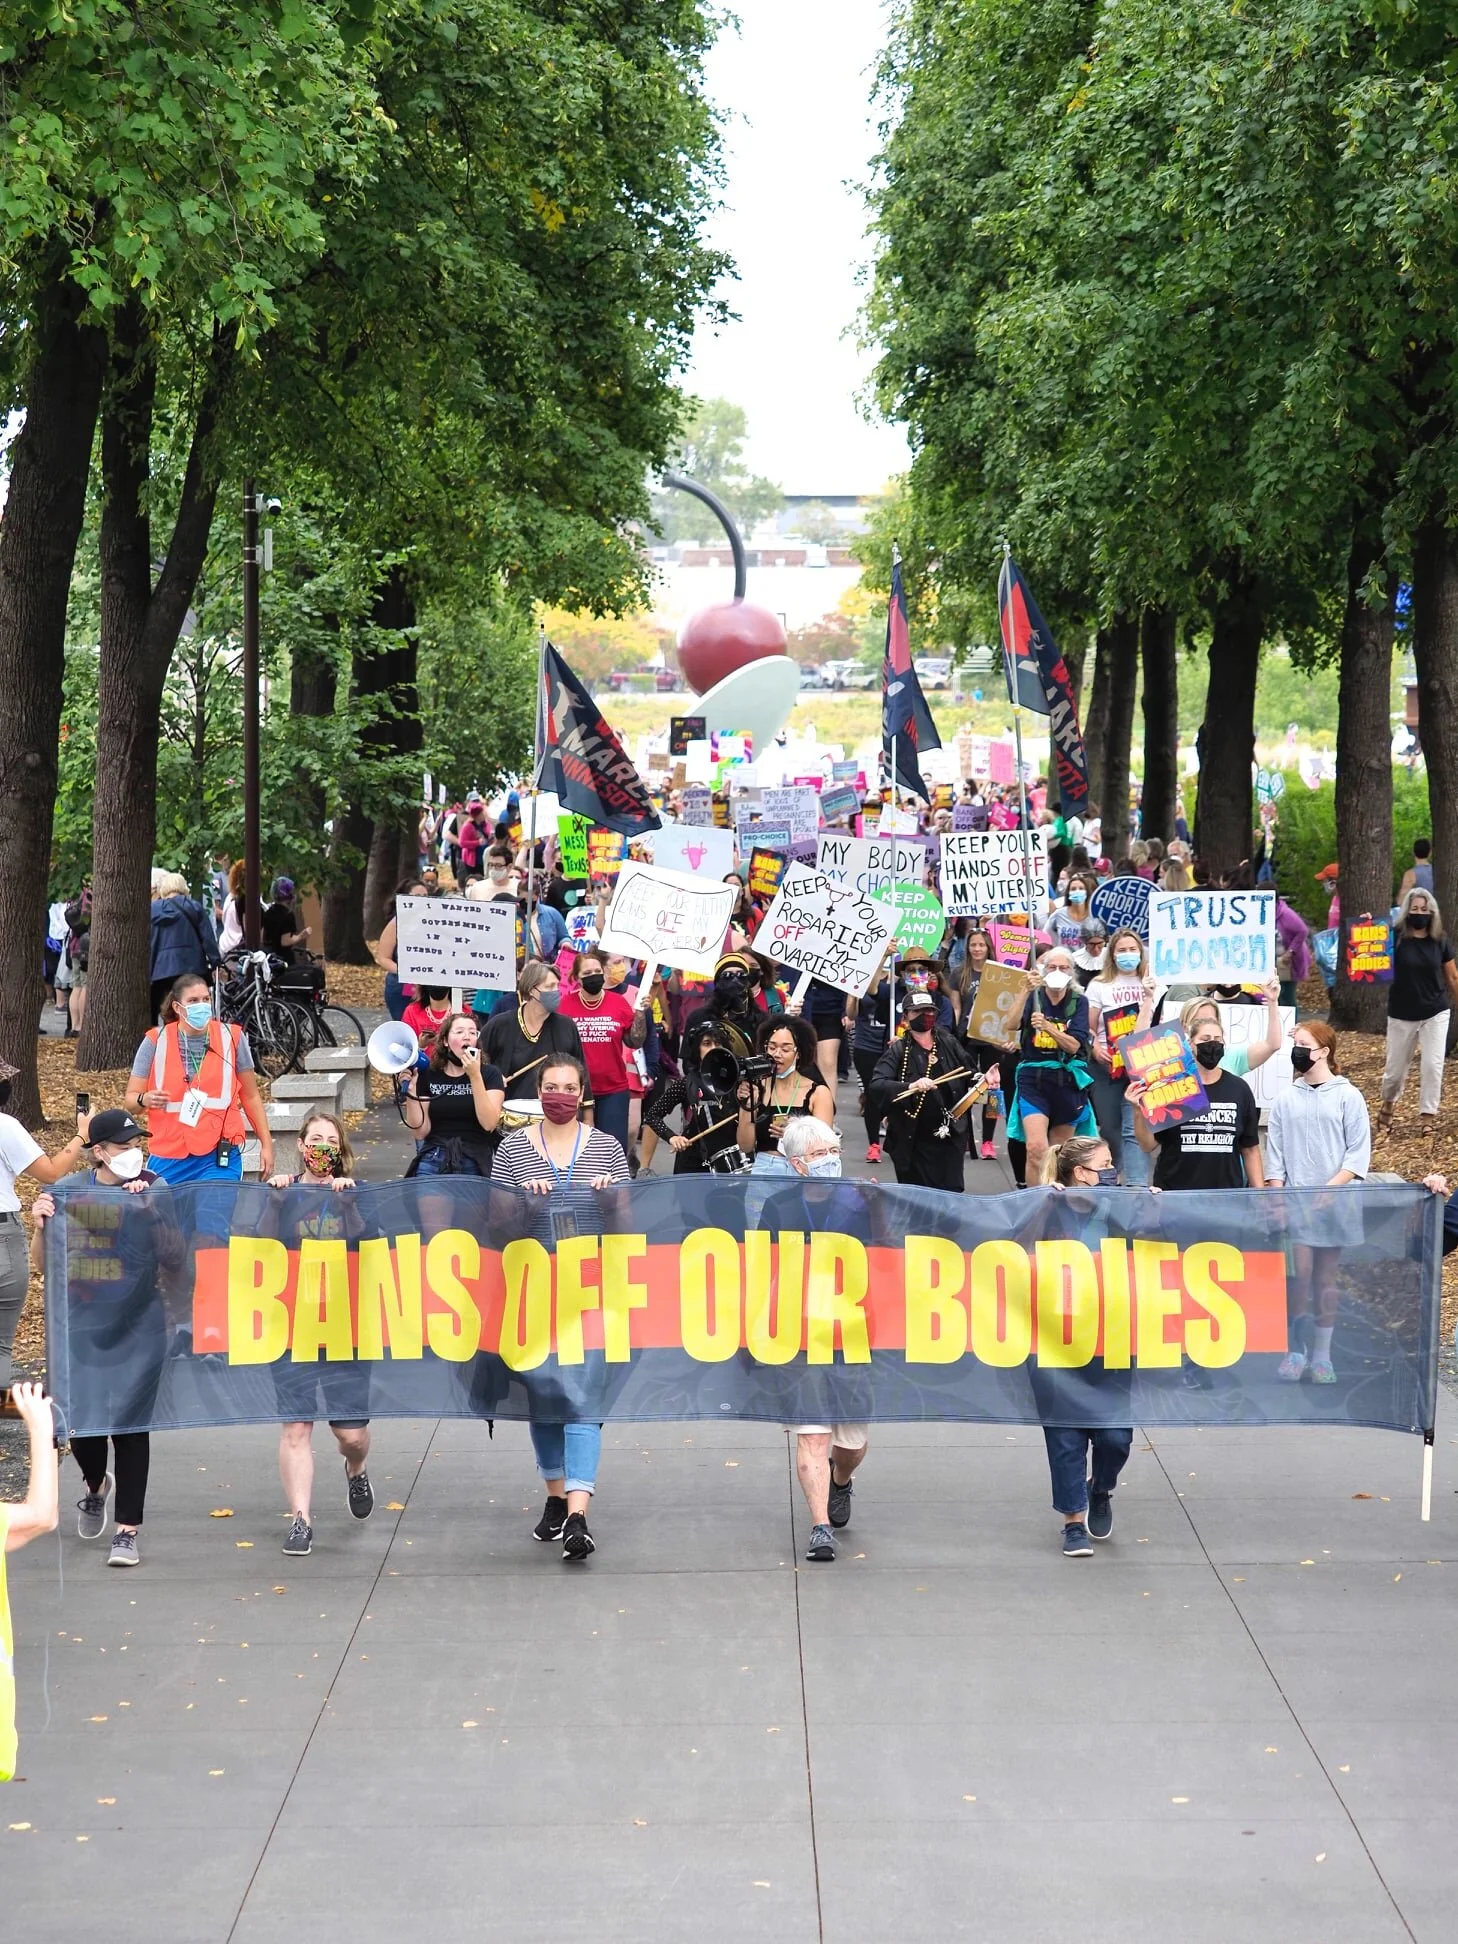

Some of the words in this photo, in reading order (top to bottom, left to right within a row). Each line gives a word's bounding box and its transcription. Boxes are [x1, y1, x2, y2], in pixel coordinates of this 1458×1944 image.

[564, 835, 585, 850] MESS
[945, 835, 990, 856] KEEP
[996, 833, 1042, 853] YOUR
[821, 841, 852, 866] MY
[868, 846, 922, 873] BODY
[945, 858, 1001, 880] HANDS
[1008, 856, 1046, 877] OFF
[782, 876, 827, 899] KEEP
[856, 872, 922, 895] CHO
[952, 881, 979, 904] MY
[1113, 880, 1150, 900] KEE
[881, 891, 926, 904] KEEP
[947, 904, 978, 915] RUTH
[982, 902, 1016, 914] SENT
[1095, 889, 1150, 918] ABORTI
[441, 903, 482, 913] WANTED
[489, 907, 508, 917] THE
[852, 893, 888, 943] YOUR
[902, 908, 940, 920] TION
[1157, 895, 1274, 930] TRUST
[421, 918, 491, 932] GOVERNMENT
[773, 924, 806, 941] OFF
[776, 901, 873, 955] ROSARIES
[901, 922, 937, 934] AND
[1060, 926, 1080, 935] BAN
[406, 946, 442, 955] UTERUS
[470, 951, 505, 961] WOULD
[896, 936, 925, 948] AL!
[826, 943, 857, 966] MY
[1154, 934, 1267, 976] WOMEN
[1108, 1014, 1138, 1037] BANS
[1229, 1006, 1292, 1045] BOY
[1129, 1035, 1182, 1070] BANS
[1142, 1075, 1200, 1110] BODIES
[1189, 1109, 1238, 1124] IENCE?
[228, 1229, 482, 1366] BANS
[498, 1234, 648, 1372] OFF
[679, 1227, 872, 1366] OUR
[904, 1235, 1247, 1369] BODIES
